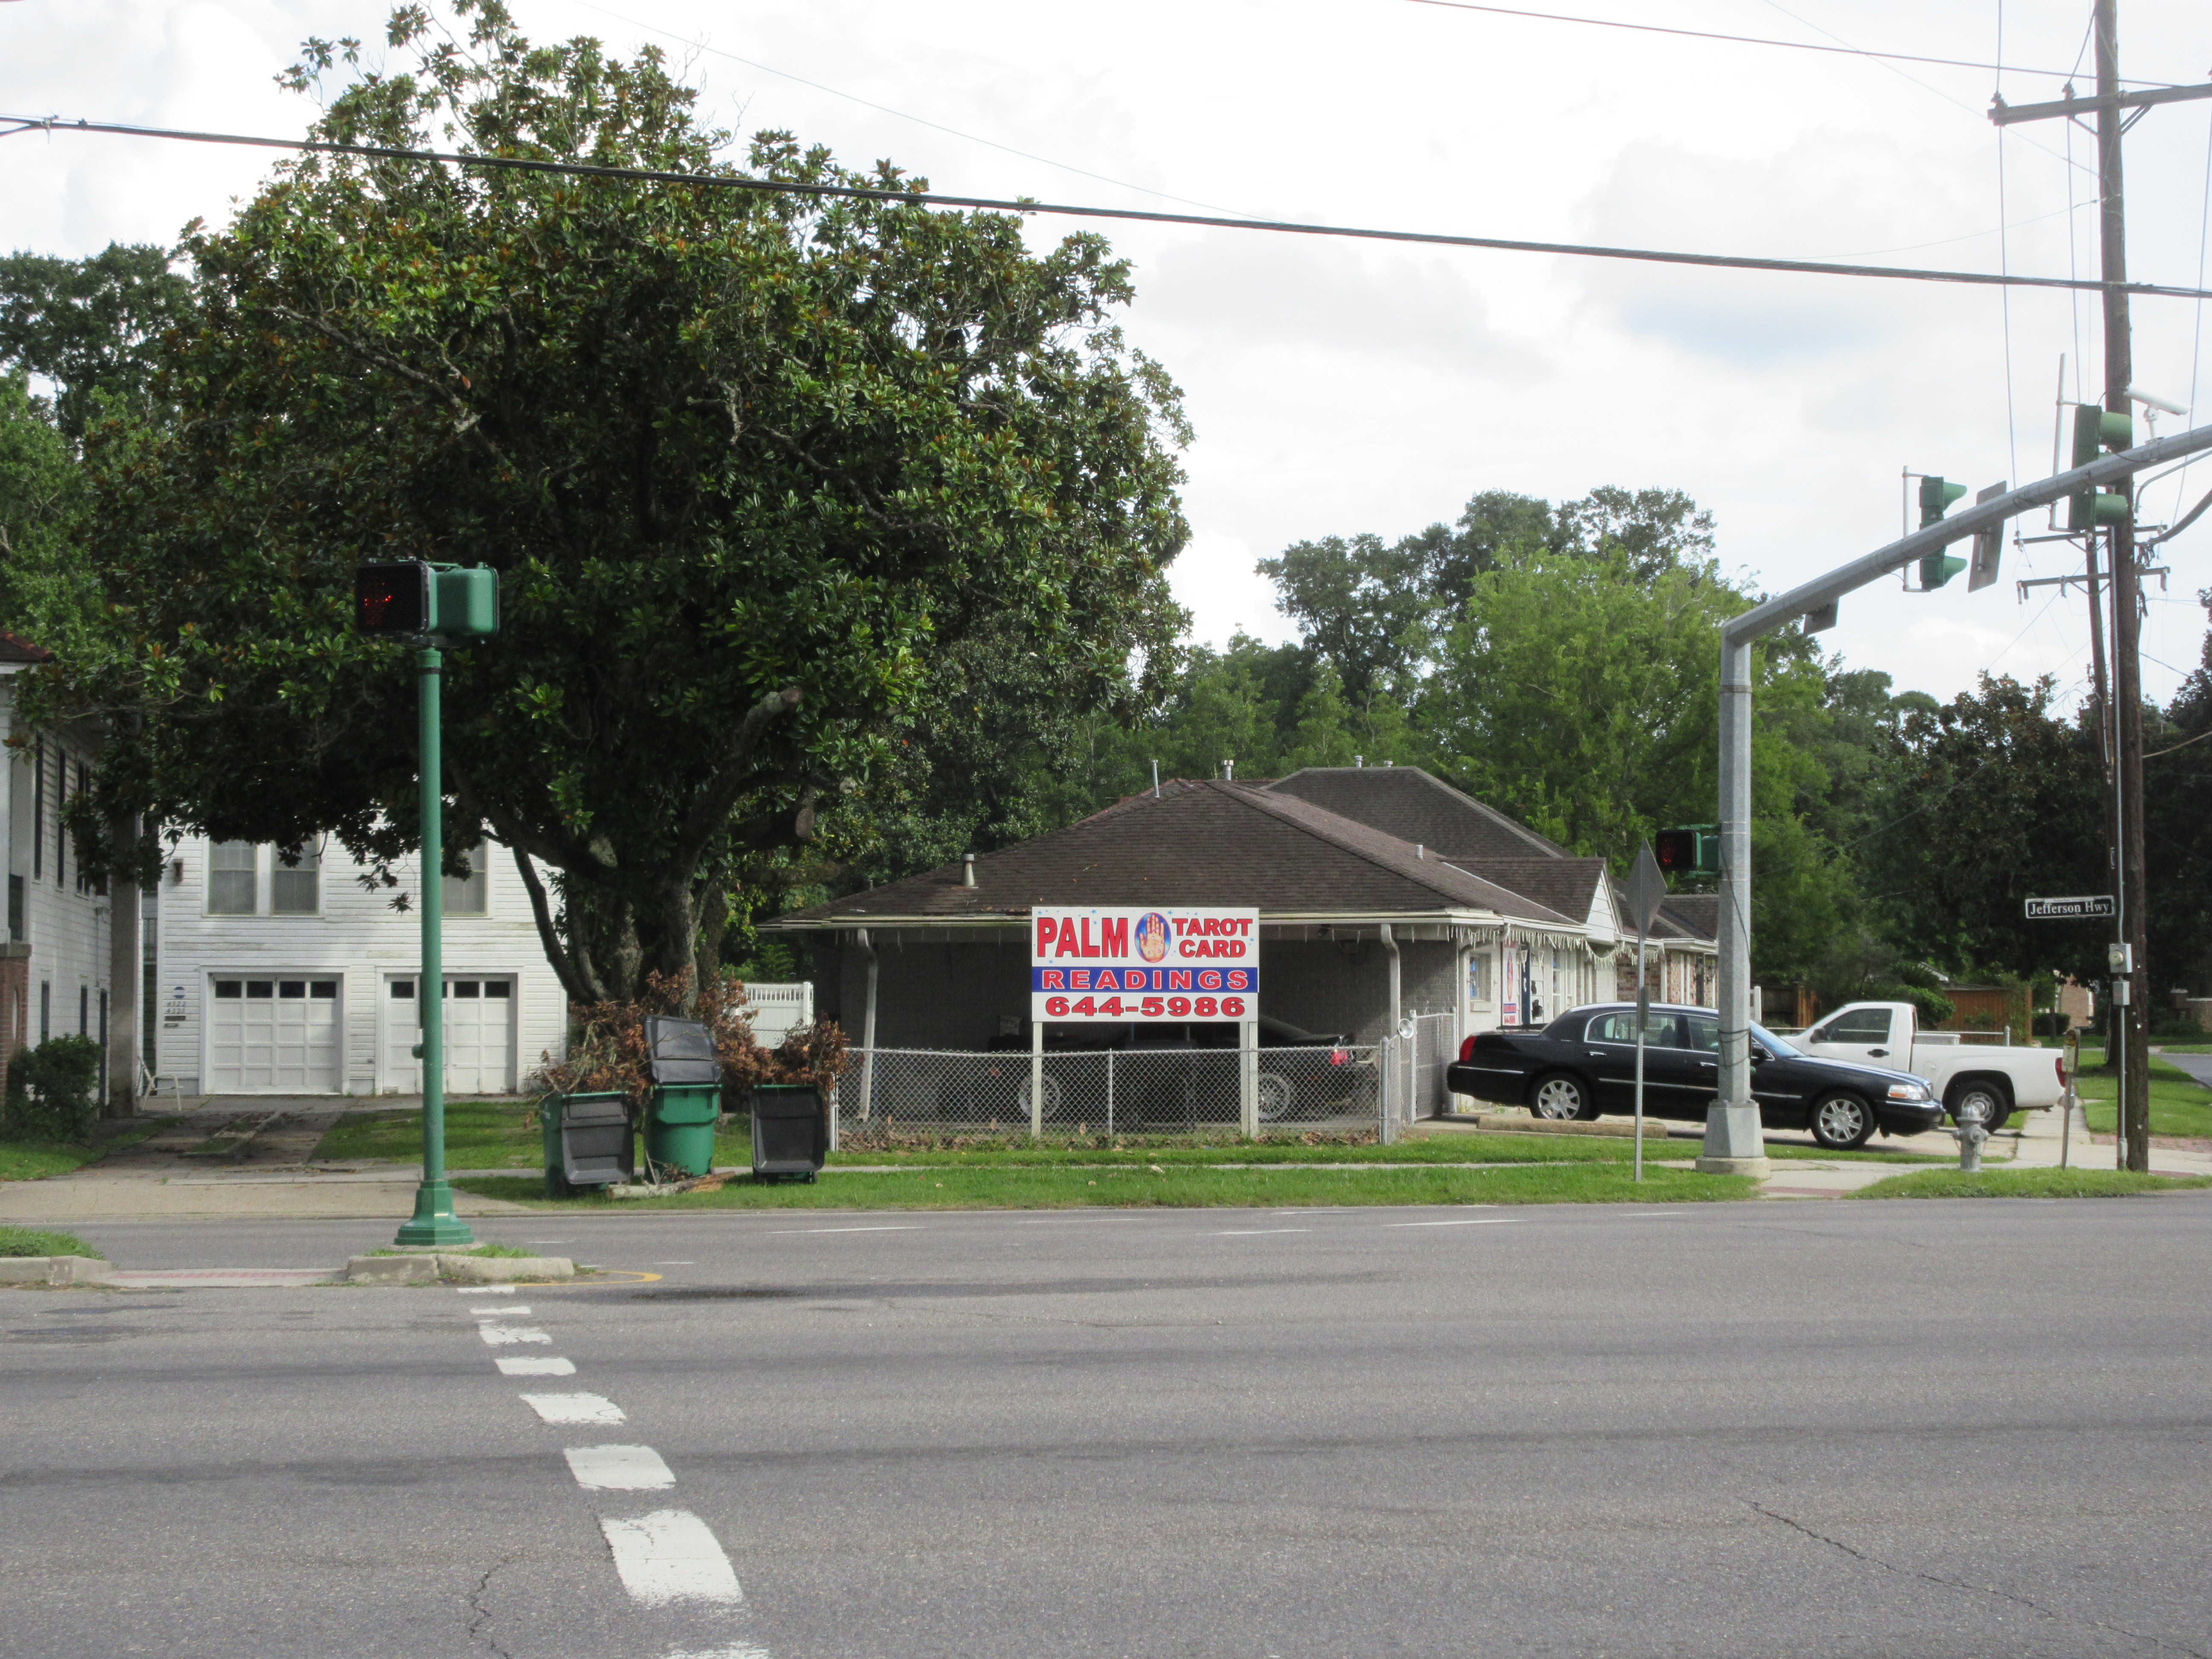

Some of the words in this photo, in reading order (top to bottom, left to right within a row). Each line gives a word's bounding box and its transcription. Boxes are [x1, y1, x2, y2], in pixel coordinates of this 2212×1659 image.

[2030, 902, 2081, 915] Jefferson
[2085, 901, 2109, 914] Hwy
[1172, 918, 1253, 936] TAROT
[1037, 917, 1128, 958] PALM
[1179, 940, 1246, 958] CARD
[1042, 970, 1248, 990] READINGS
[1045, 996, 1245, 1016] 644-5986
